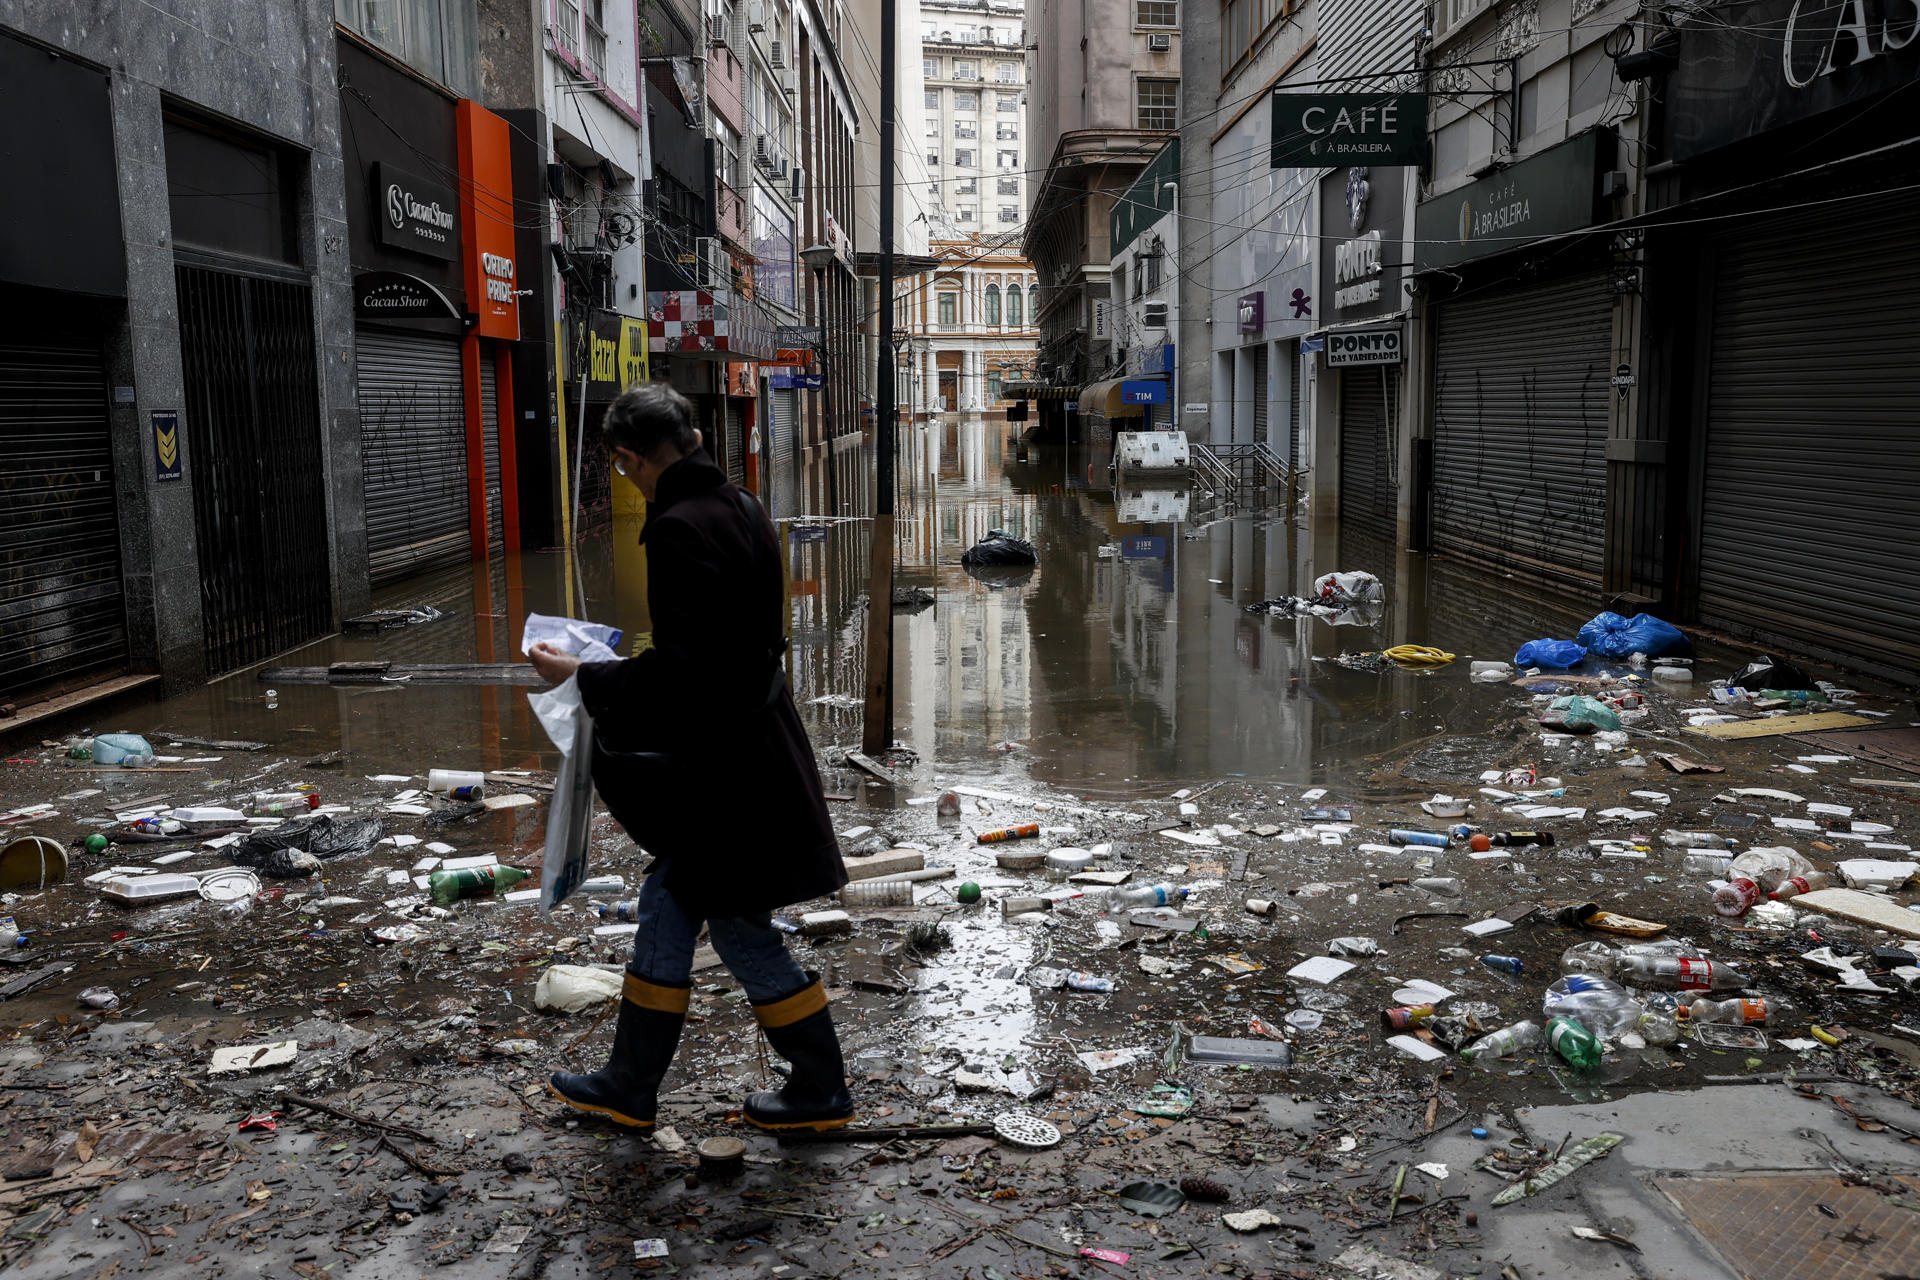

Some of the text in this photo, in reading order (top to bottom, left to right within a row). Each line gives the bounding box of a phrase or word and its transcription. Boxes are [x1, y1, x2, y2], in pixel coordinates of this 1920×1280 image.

[1301, 98, 1398, 136] CAFÉ
[1326, 141, 1392, 153] À BRASILEIRA
[1489, 179, 1516, 204] CAFÉ
[1473, 198, 1531, 238] À BRASILEIRA
[482, 252, 514, 281] ORTHO
[1335, 229, 1381, 285] PONTO
[487, 278, 513, 304] PRIDE
[1096, 303, 1104, 336] BOHEMIA
[590, 329, 617, 383] Bazar
[1330, 332, 1399, 353] PONTO
[1330, 351, 1399, 364] DAS VARIEDADES
[1135, 392, 1153, 401] TIM
